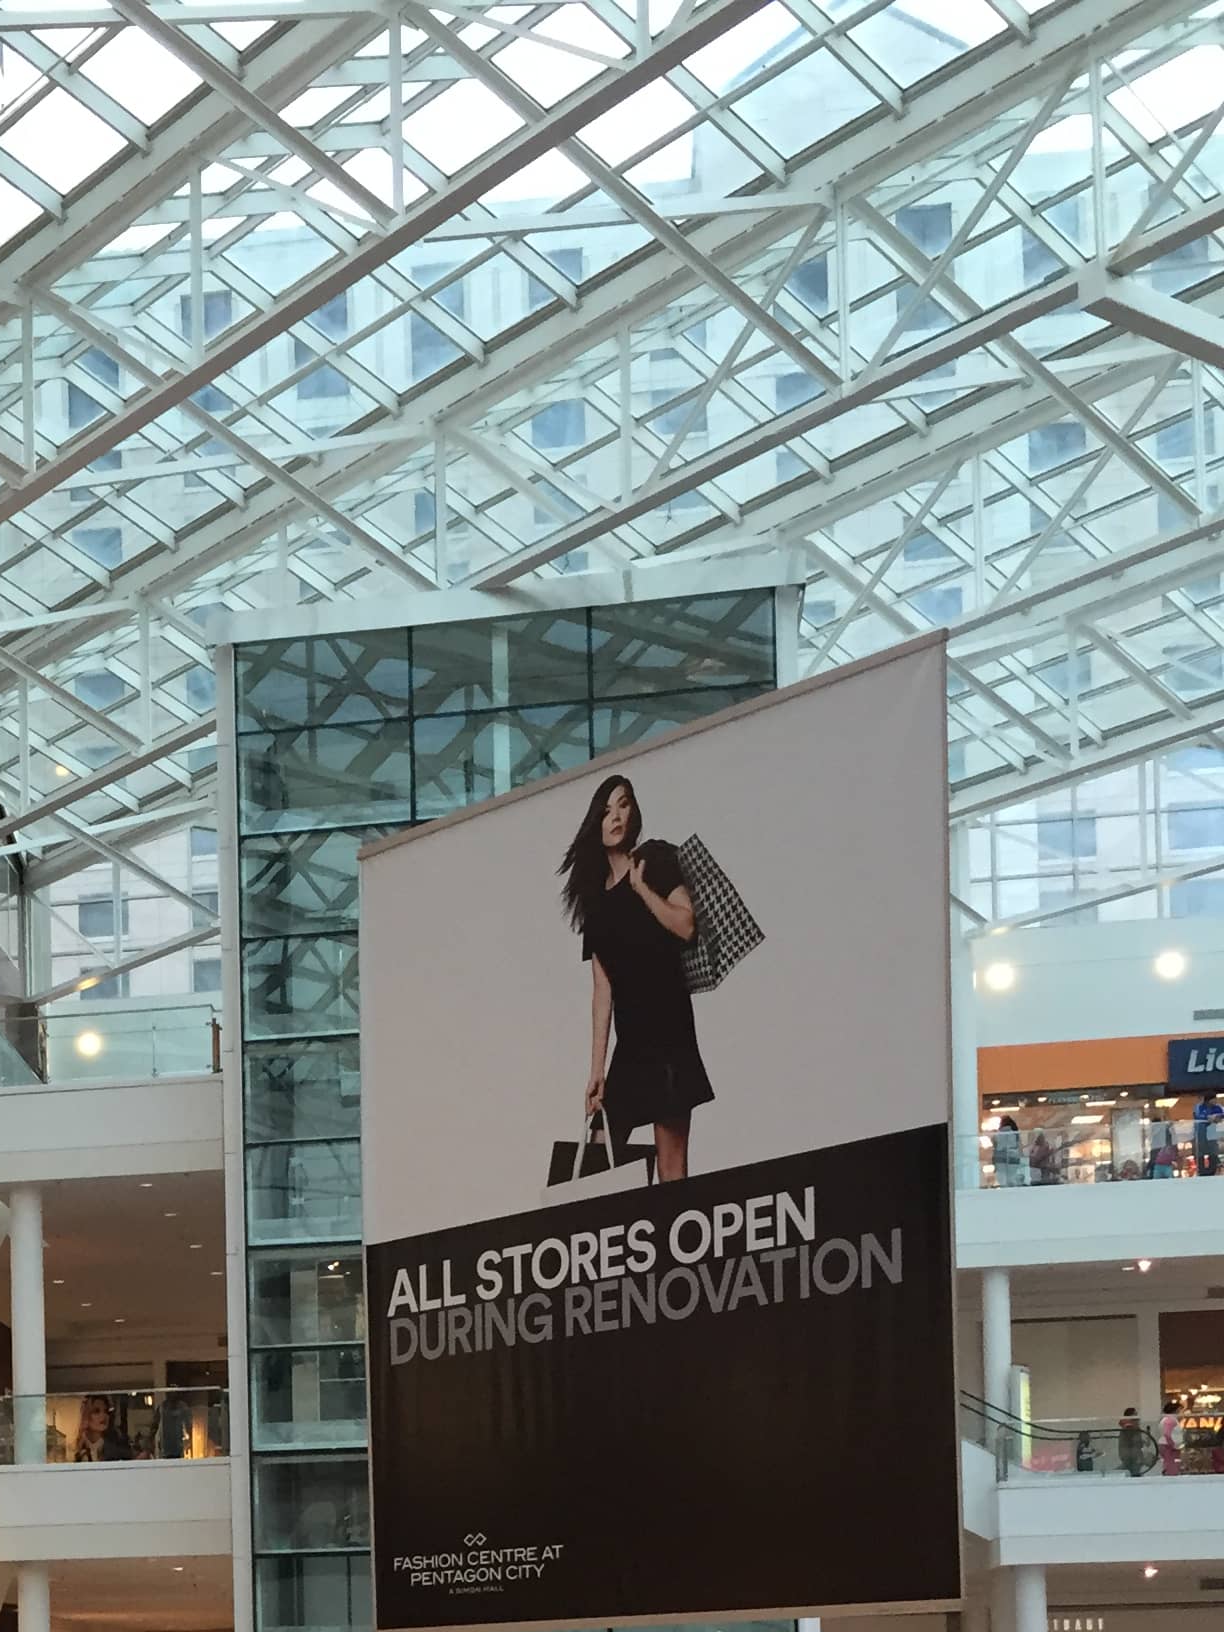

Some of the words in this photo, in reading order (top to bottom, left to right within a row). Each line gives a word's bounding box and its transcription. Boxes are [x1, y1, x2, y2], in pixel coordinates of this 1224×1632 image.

[387, 1259, 466, 1317] ALL
[476, 1219, 657, 1300] STORES
[669, 1185, 816, 1264] OPEN
[389, 1293, 553, 1366] DURING
[565, 1227, 903, 1337] RENOVATION
[393, 1553, 463, 1571] FASHION
[467, 1547, 538, 1565] CENTRE
[541, 1544, 564, 1560] AT
[410, 1566, 502, 1586] PENTAGON
[505, 1563, 545, 1580] CITY
